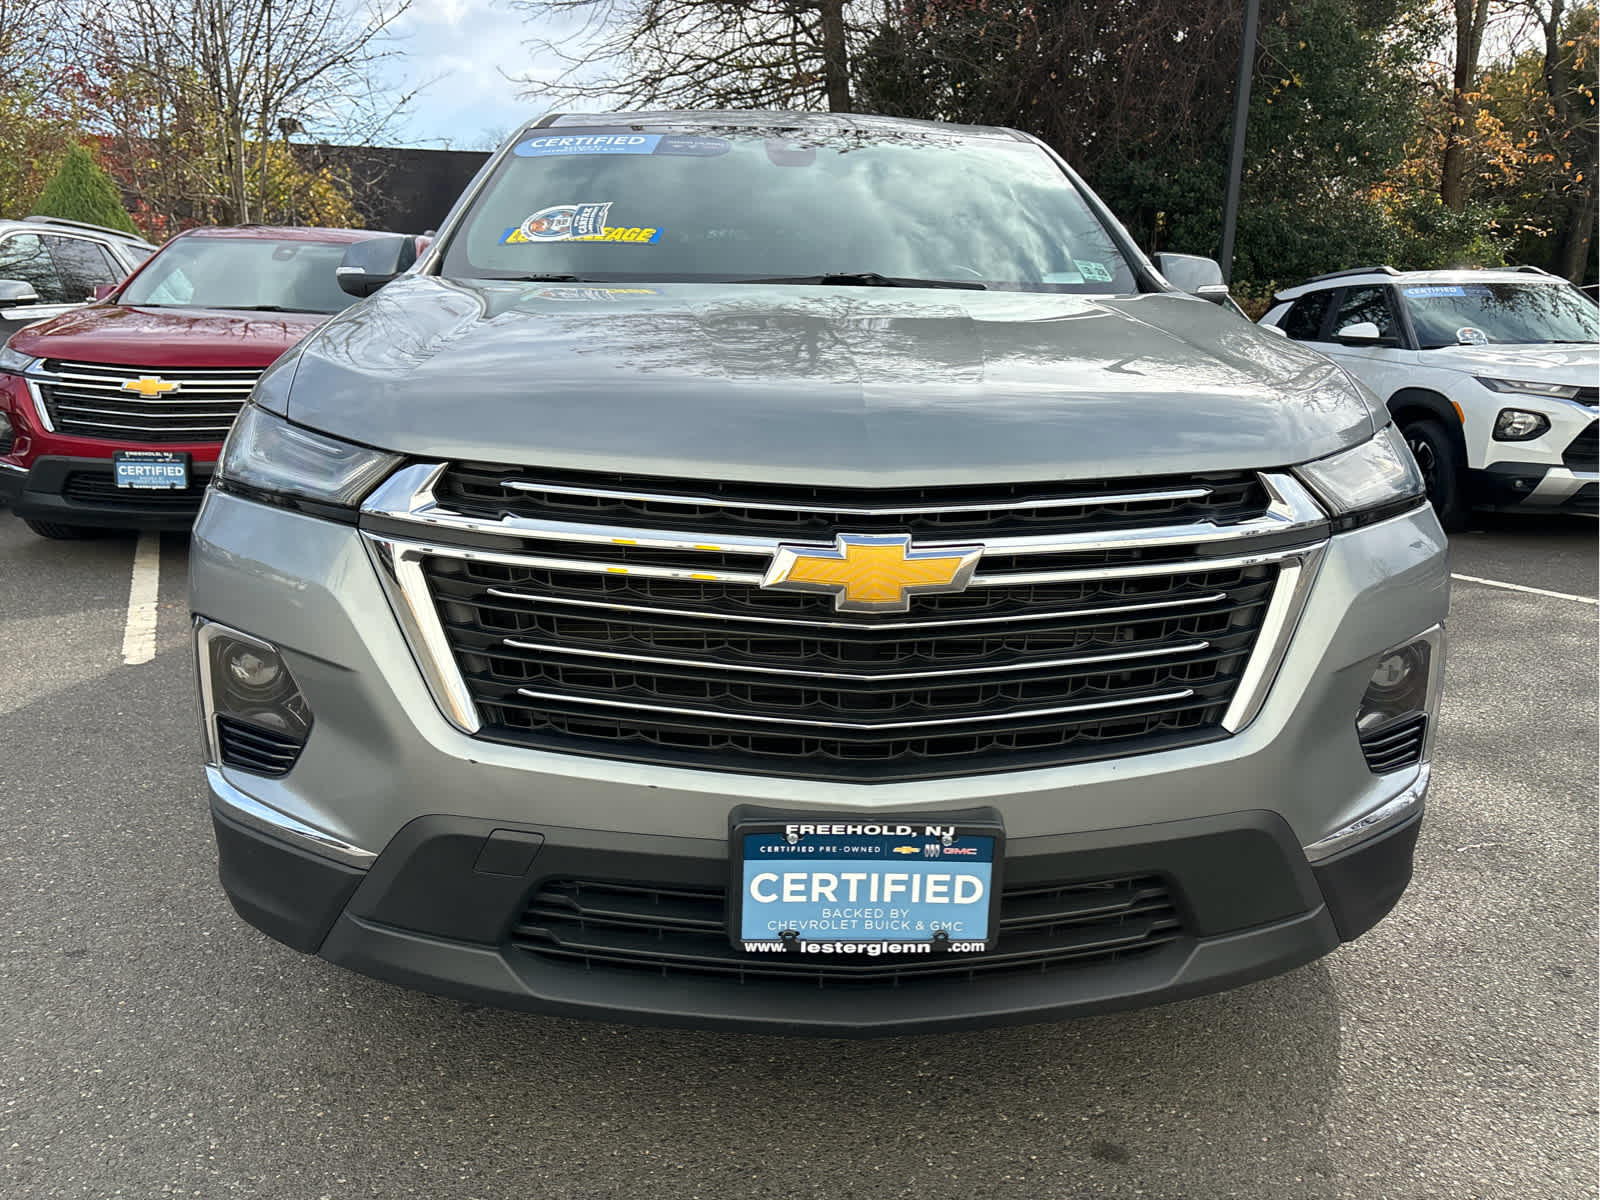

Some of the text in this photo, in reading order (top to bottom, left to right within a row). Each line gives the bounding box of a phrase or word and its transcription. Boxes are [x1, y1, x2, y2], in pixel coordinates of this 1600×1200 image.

[530, 136, 647, 148] CERTIFIED
[578, 207, 594, 234] CARFAX
[1407, 287, 1457, 295] CERTIFIED
[119, 466, 184, 476] CERTIFIED
[785, 824, 955, 837] FREEHOLD, NJ
[759, 845, 815, 853] CERTIFIED
[750, 872, 984, 904] CERTIFIED
[821, 908, 910, 919] BACKED BY
[767, 920, 964, 932] CHEVROLET BUICK & GMC
[744, 941, 985, 957] www. lesterglenn .com
